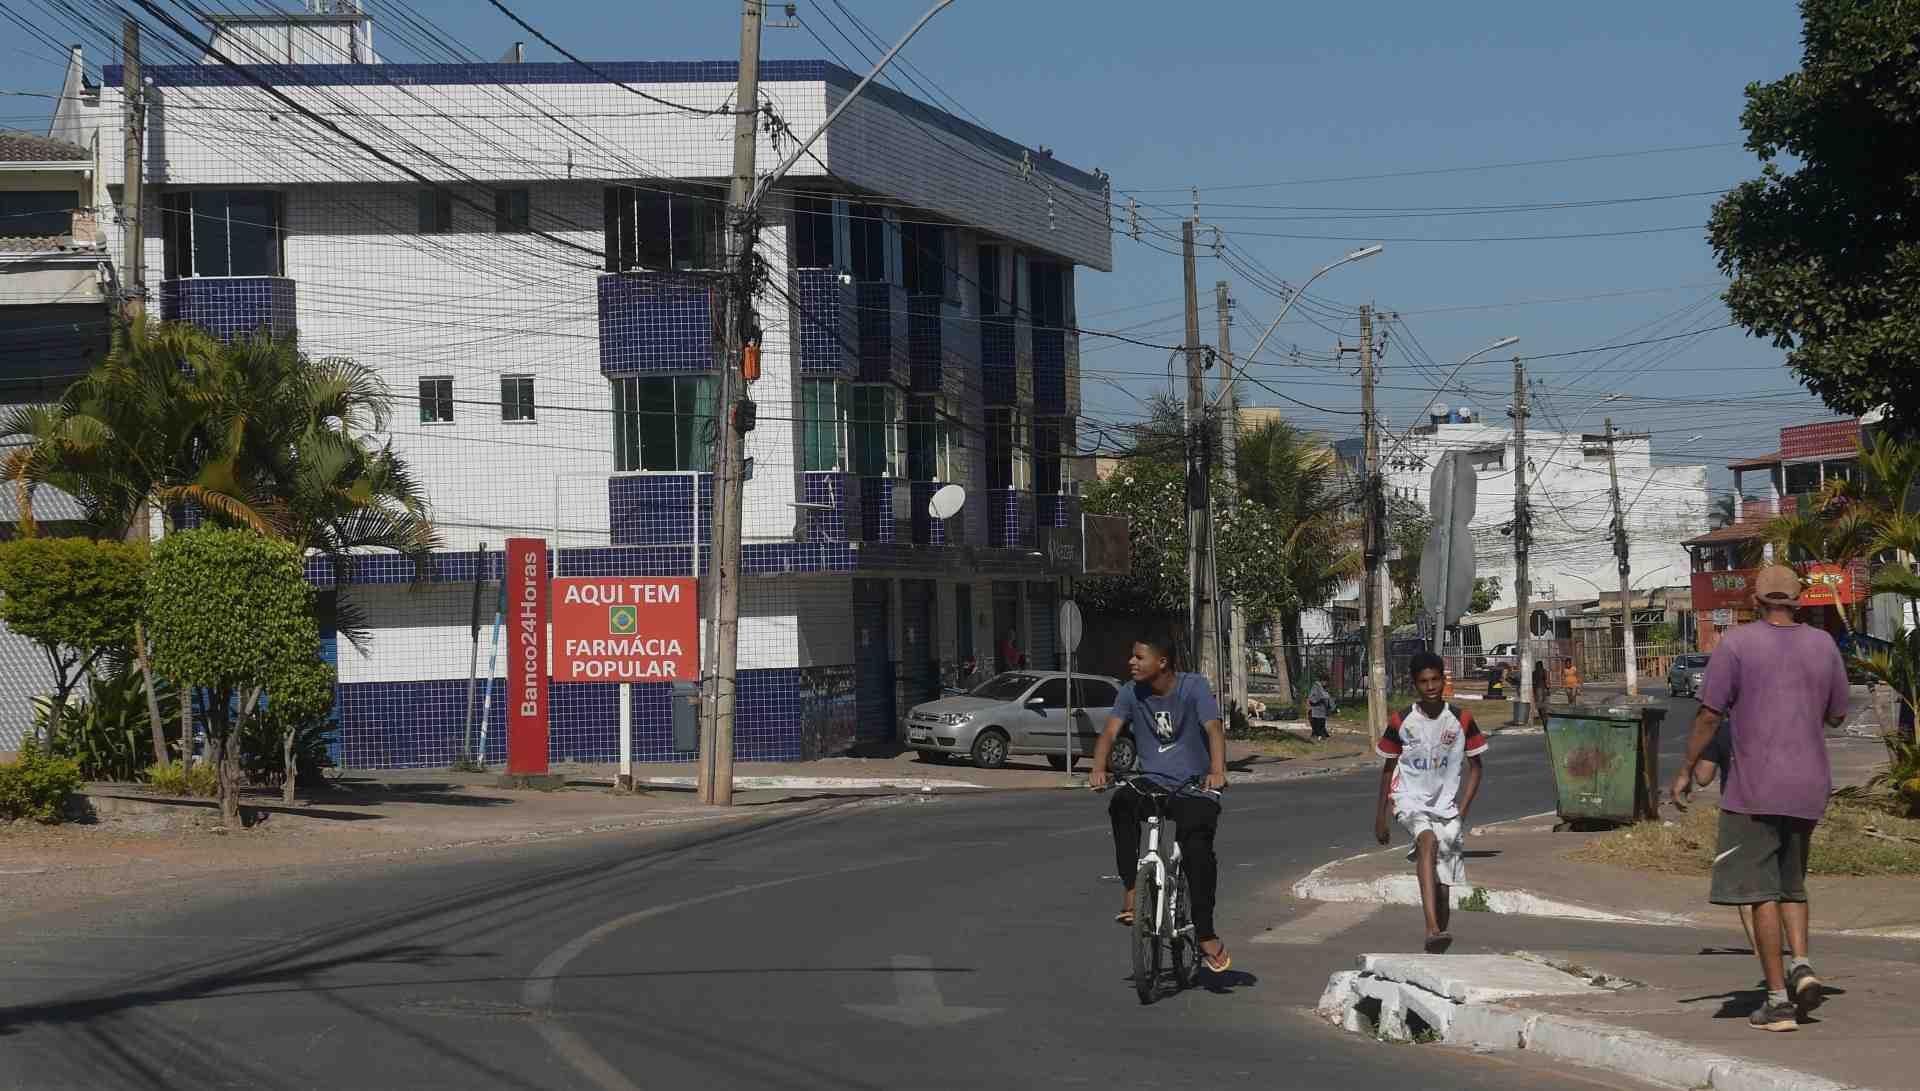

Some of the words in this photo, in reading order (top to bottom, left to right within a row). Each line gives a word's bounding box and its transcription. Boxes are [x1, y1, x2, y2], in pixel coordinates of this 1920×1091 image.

[564, 584, 624, 606] AQUI
[630, 584, 680, 604] TEM
[521, 551, 537, 717] Banco24Horas
[566, 635, 682, 656] FARMÁCIA
[572, 660, 676, 678] POPULAR
